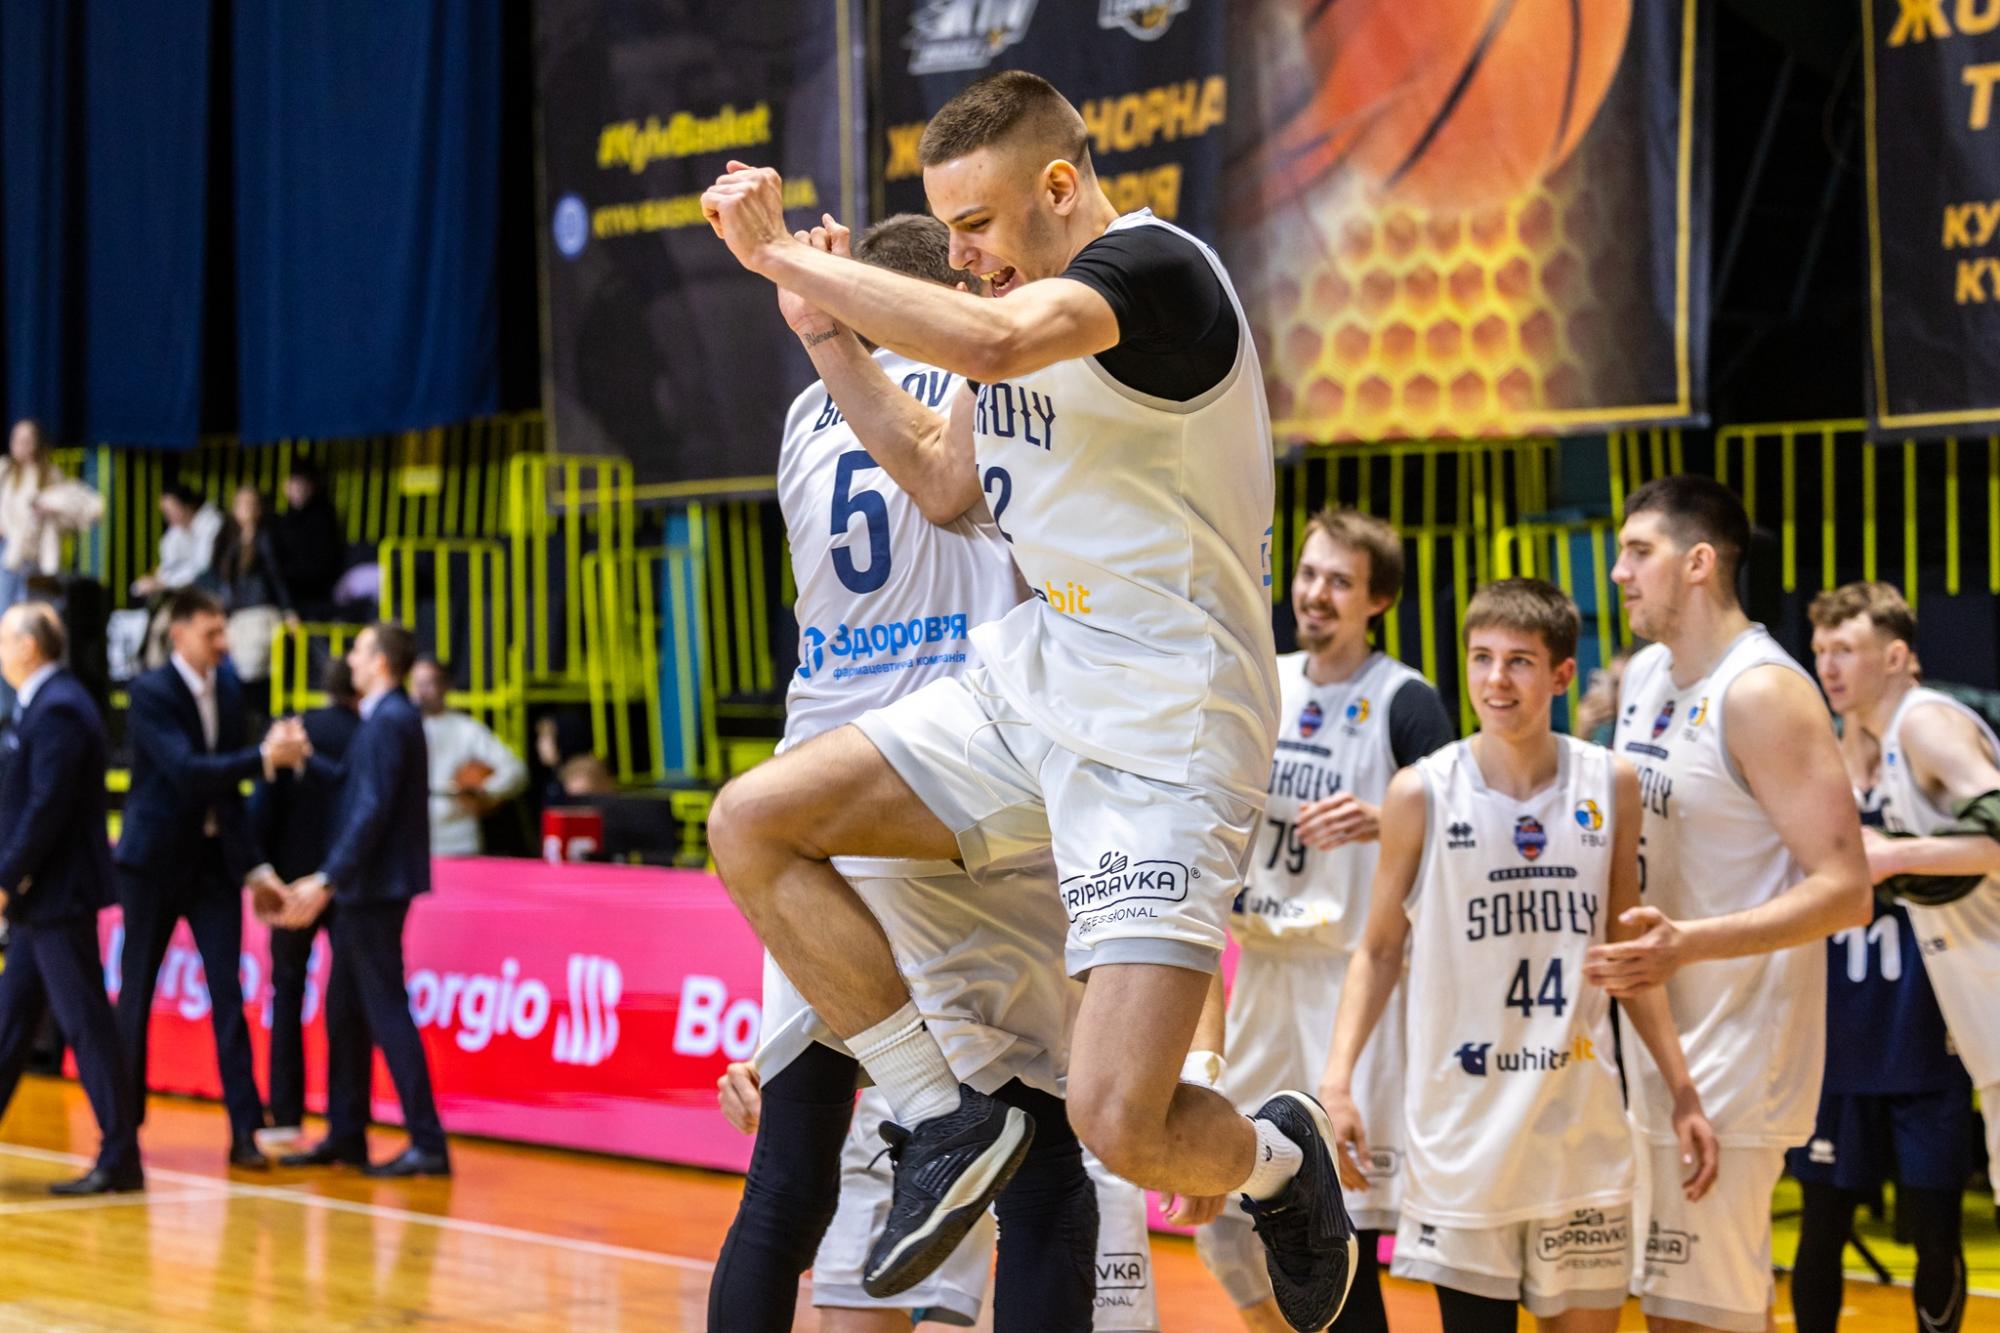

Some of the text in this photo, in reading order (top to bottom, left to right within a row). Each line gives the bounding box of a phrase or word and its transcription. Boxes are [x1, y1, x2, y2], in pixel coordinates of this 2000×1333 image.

[830, 449, 893, 594] 5
[1063, 870, 1175, 910] RIPRAVKA
[1467, 890, 1598, 942] SOKOLY
[407, 957, 549, 1052] orgio
[1505, 958, 1567, 1017] 44
